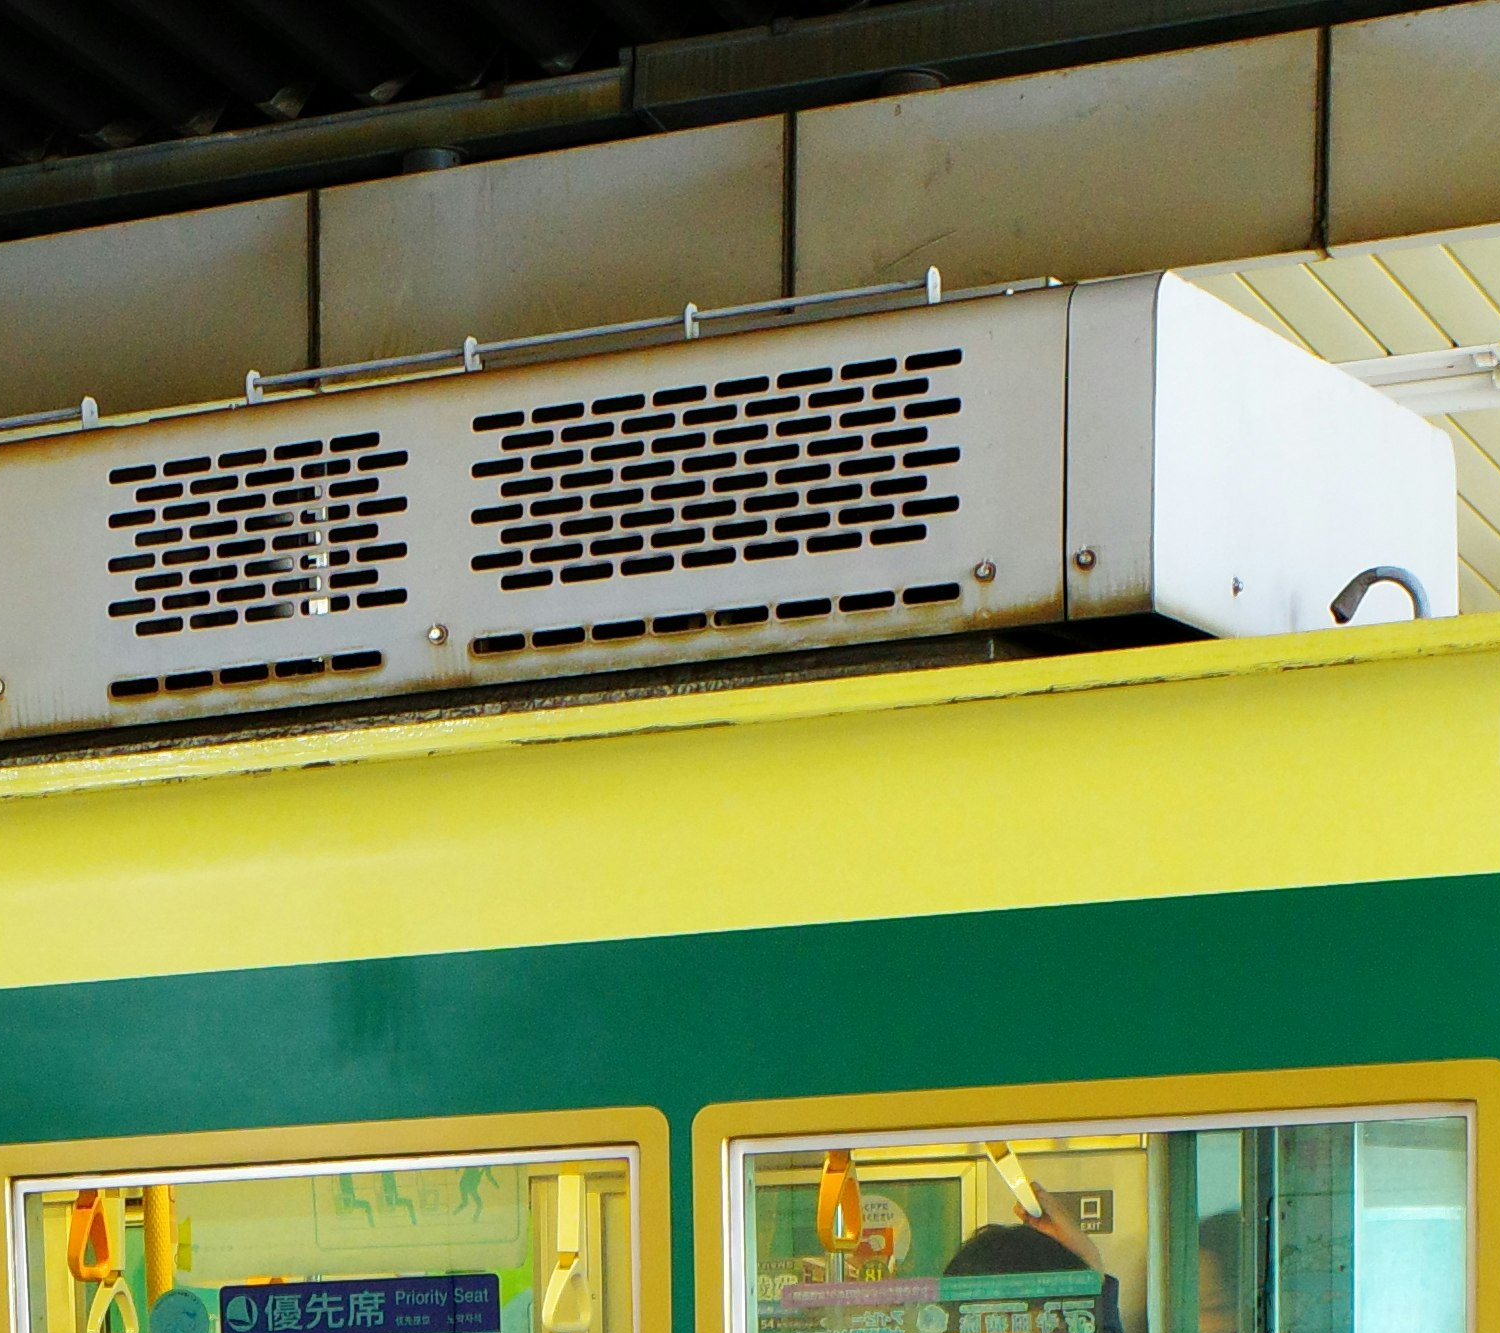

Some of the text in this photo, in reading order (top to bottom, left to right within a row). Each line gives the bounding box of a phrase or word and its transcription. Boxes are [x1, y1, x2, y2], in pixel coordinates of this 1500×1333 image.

[264, 1291, 386, 1331] 優先席
[395, 1287, 489, 1307] Priority Seat
